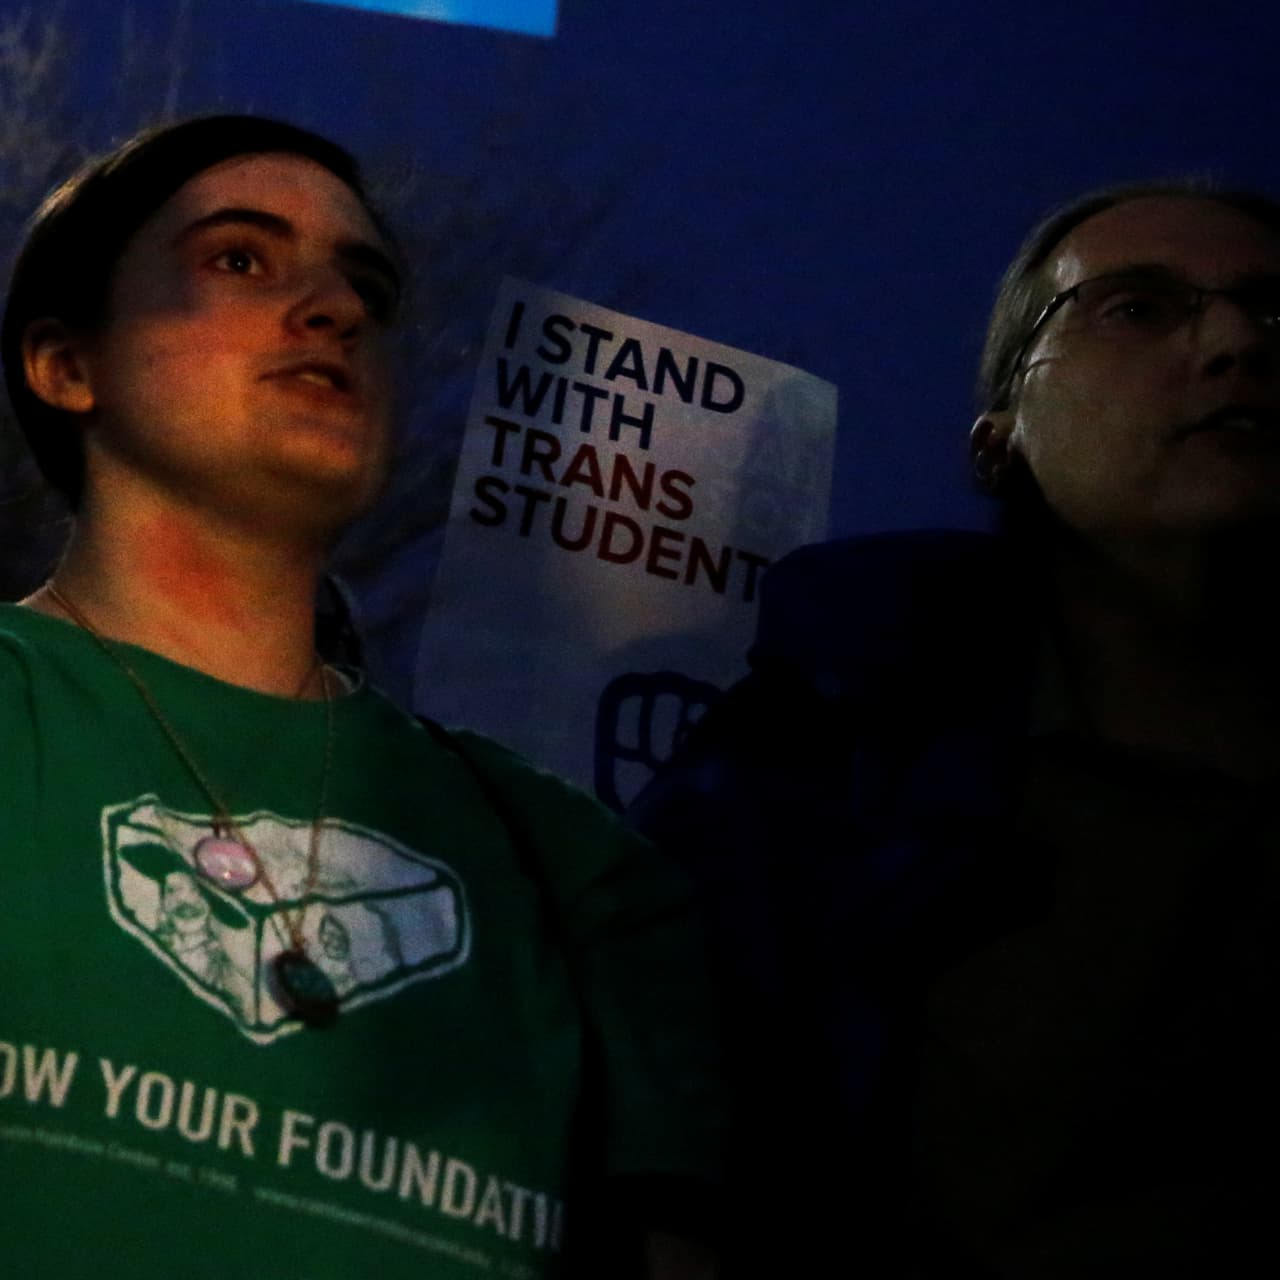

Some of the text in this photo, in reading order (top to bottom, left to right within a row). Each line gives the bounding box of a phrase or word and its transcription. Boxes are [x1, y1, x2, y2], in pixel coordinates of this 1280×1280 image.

[496, 357, 655, 450] WITH
[504, 302, 745, 415] I STAND
[484, 416, 696, 520] TRANS
[98, 1057, 259, 1158] YOUR
